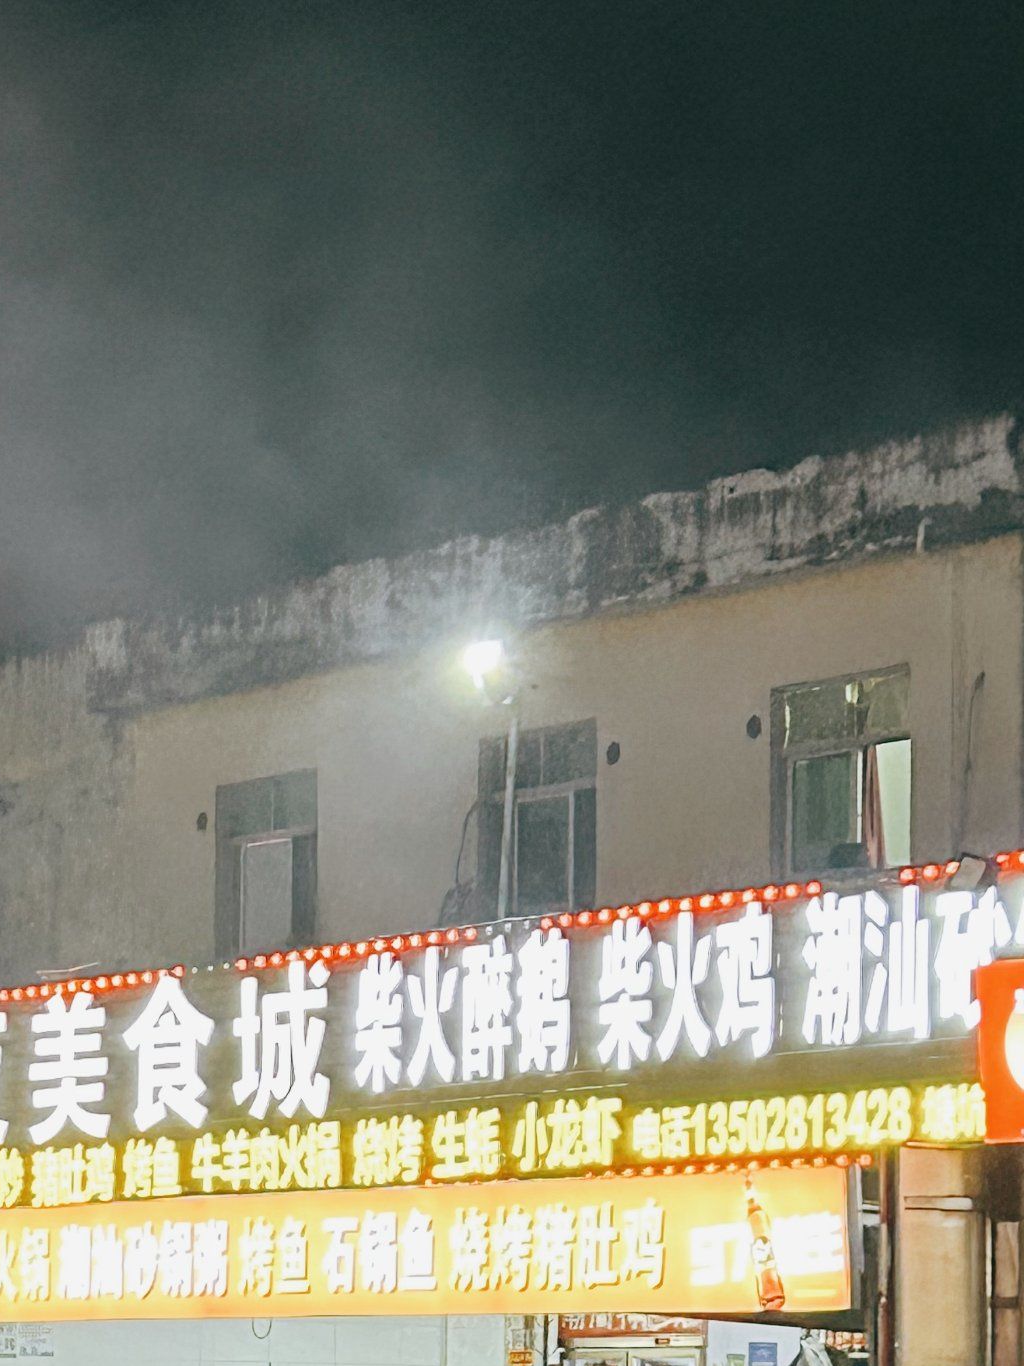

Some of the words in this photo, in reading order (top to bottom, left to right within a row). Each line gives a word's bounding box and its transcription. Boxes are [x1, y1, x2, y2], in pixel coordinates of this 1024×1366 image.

[355, 927, 571, 1094] 柴火醉鹅
[597, 901, 775, 1070] 柴火鸡
[802, 884, 1024, 1046] 潮汕砂
[31, 1141, 116, 1208] 猪肚鸡
[123, 1136, 182, 1198] 烤鱼
[190, 1120, 342, 1192] 牛羊肉火锅
[352, 1113, 424, 1184] 烧烤
[432, 1108, 500, 1178] 生蚝
[511, 1096, 623, 1171] 小龙虾
[238, 1214, 313, 1297] 烤鱼
[322, 1208, 440, 1295] 石锅鱼
